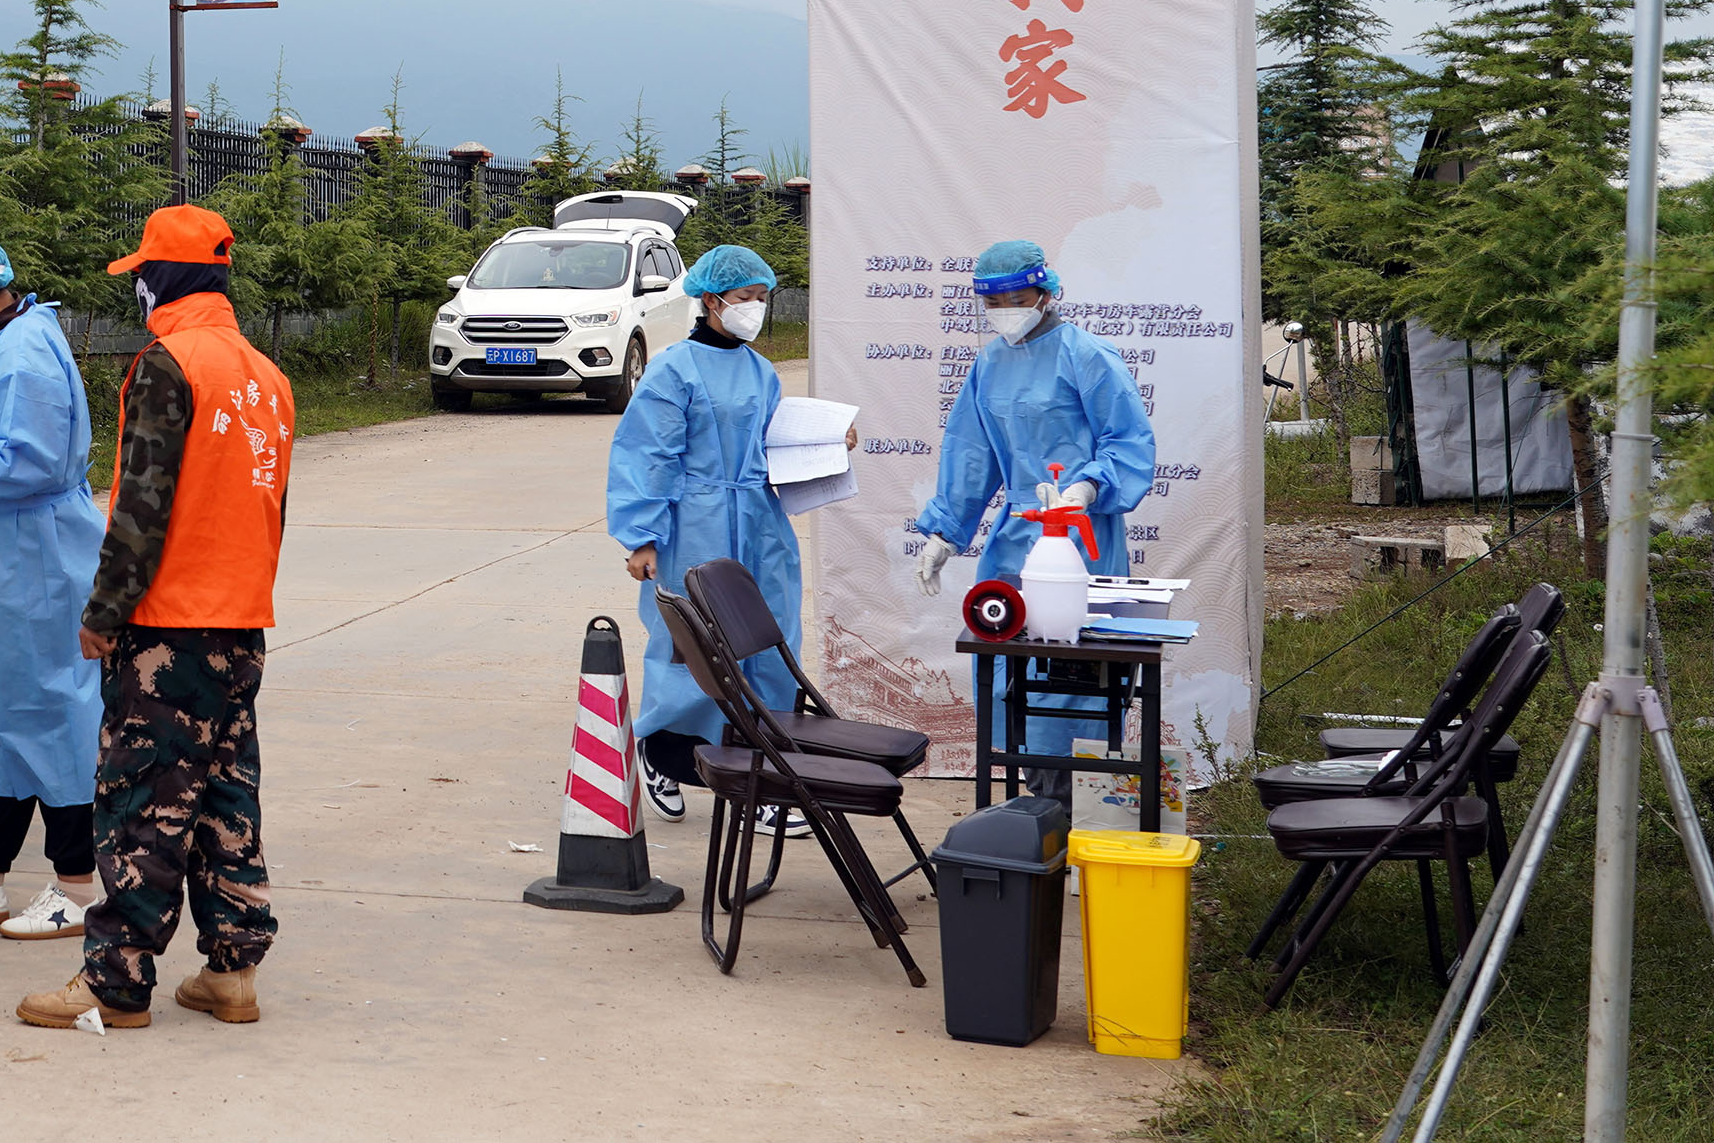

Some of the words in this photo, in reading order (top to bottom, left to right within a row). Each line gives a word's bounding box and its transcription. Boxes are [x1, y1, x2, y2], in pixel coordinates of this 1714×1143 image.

[866, 256, 932, 272] 支持单位：
[866, 282, 933, 298] 主办单位：
[1068, 320, 1233, 337] （北京）有限责任公司
[866, 344, 932, 359] 协办单位：
[1119, 348, 1155, 364] 公司
[864, 439, 931, 455] 联办单位：
